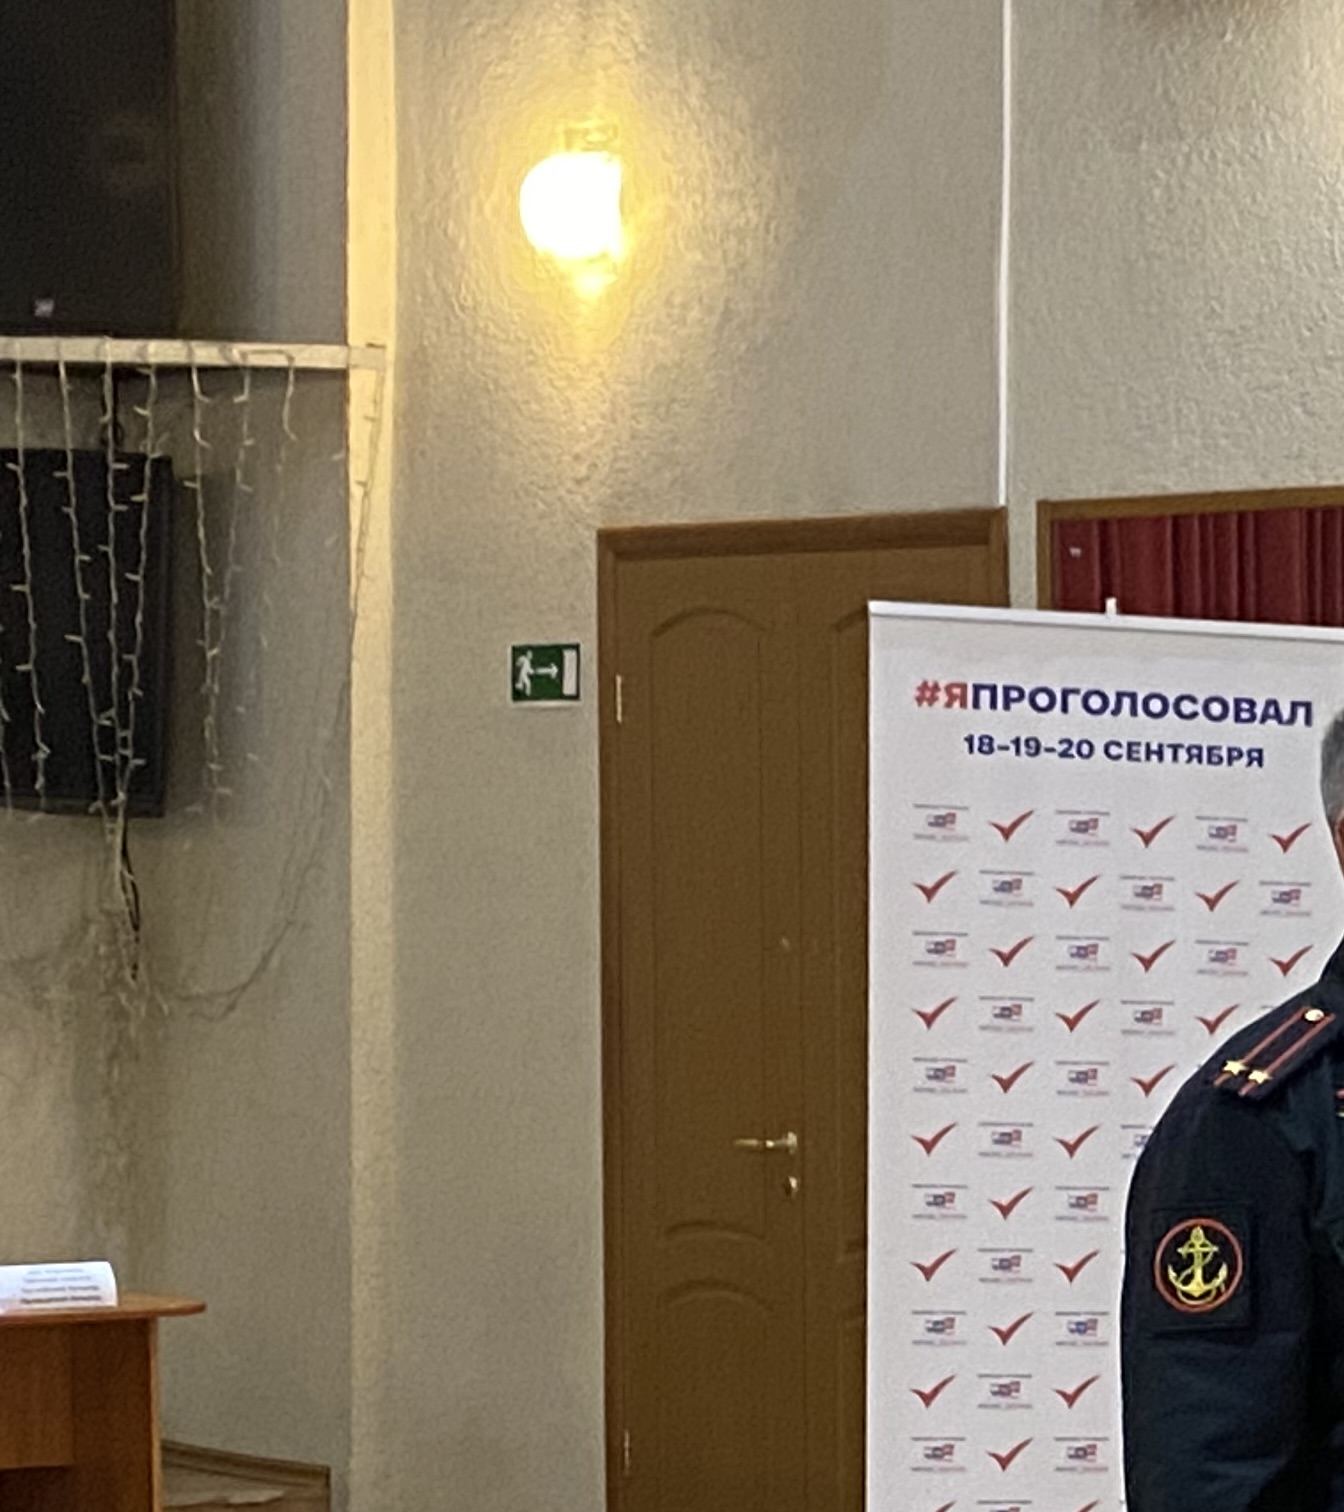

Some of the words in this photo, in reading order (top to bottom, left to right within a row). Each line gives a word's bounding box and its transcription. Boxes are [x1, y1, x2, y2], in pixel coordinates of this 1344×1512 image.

[914, 680, 1314, 728] #ЯПРОГОЛОСОВАЛ
[963, 733, 1096, 760] 18-19-20
[1103, 739, 1265, 768] СЕНТЯБРЯ
